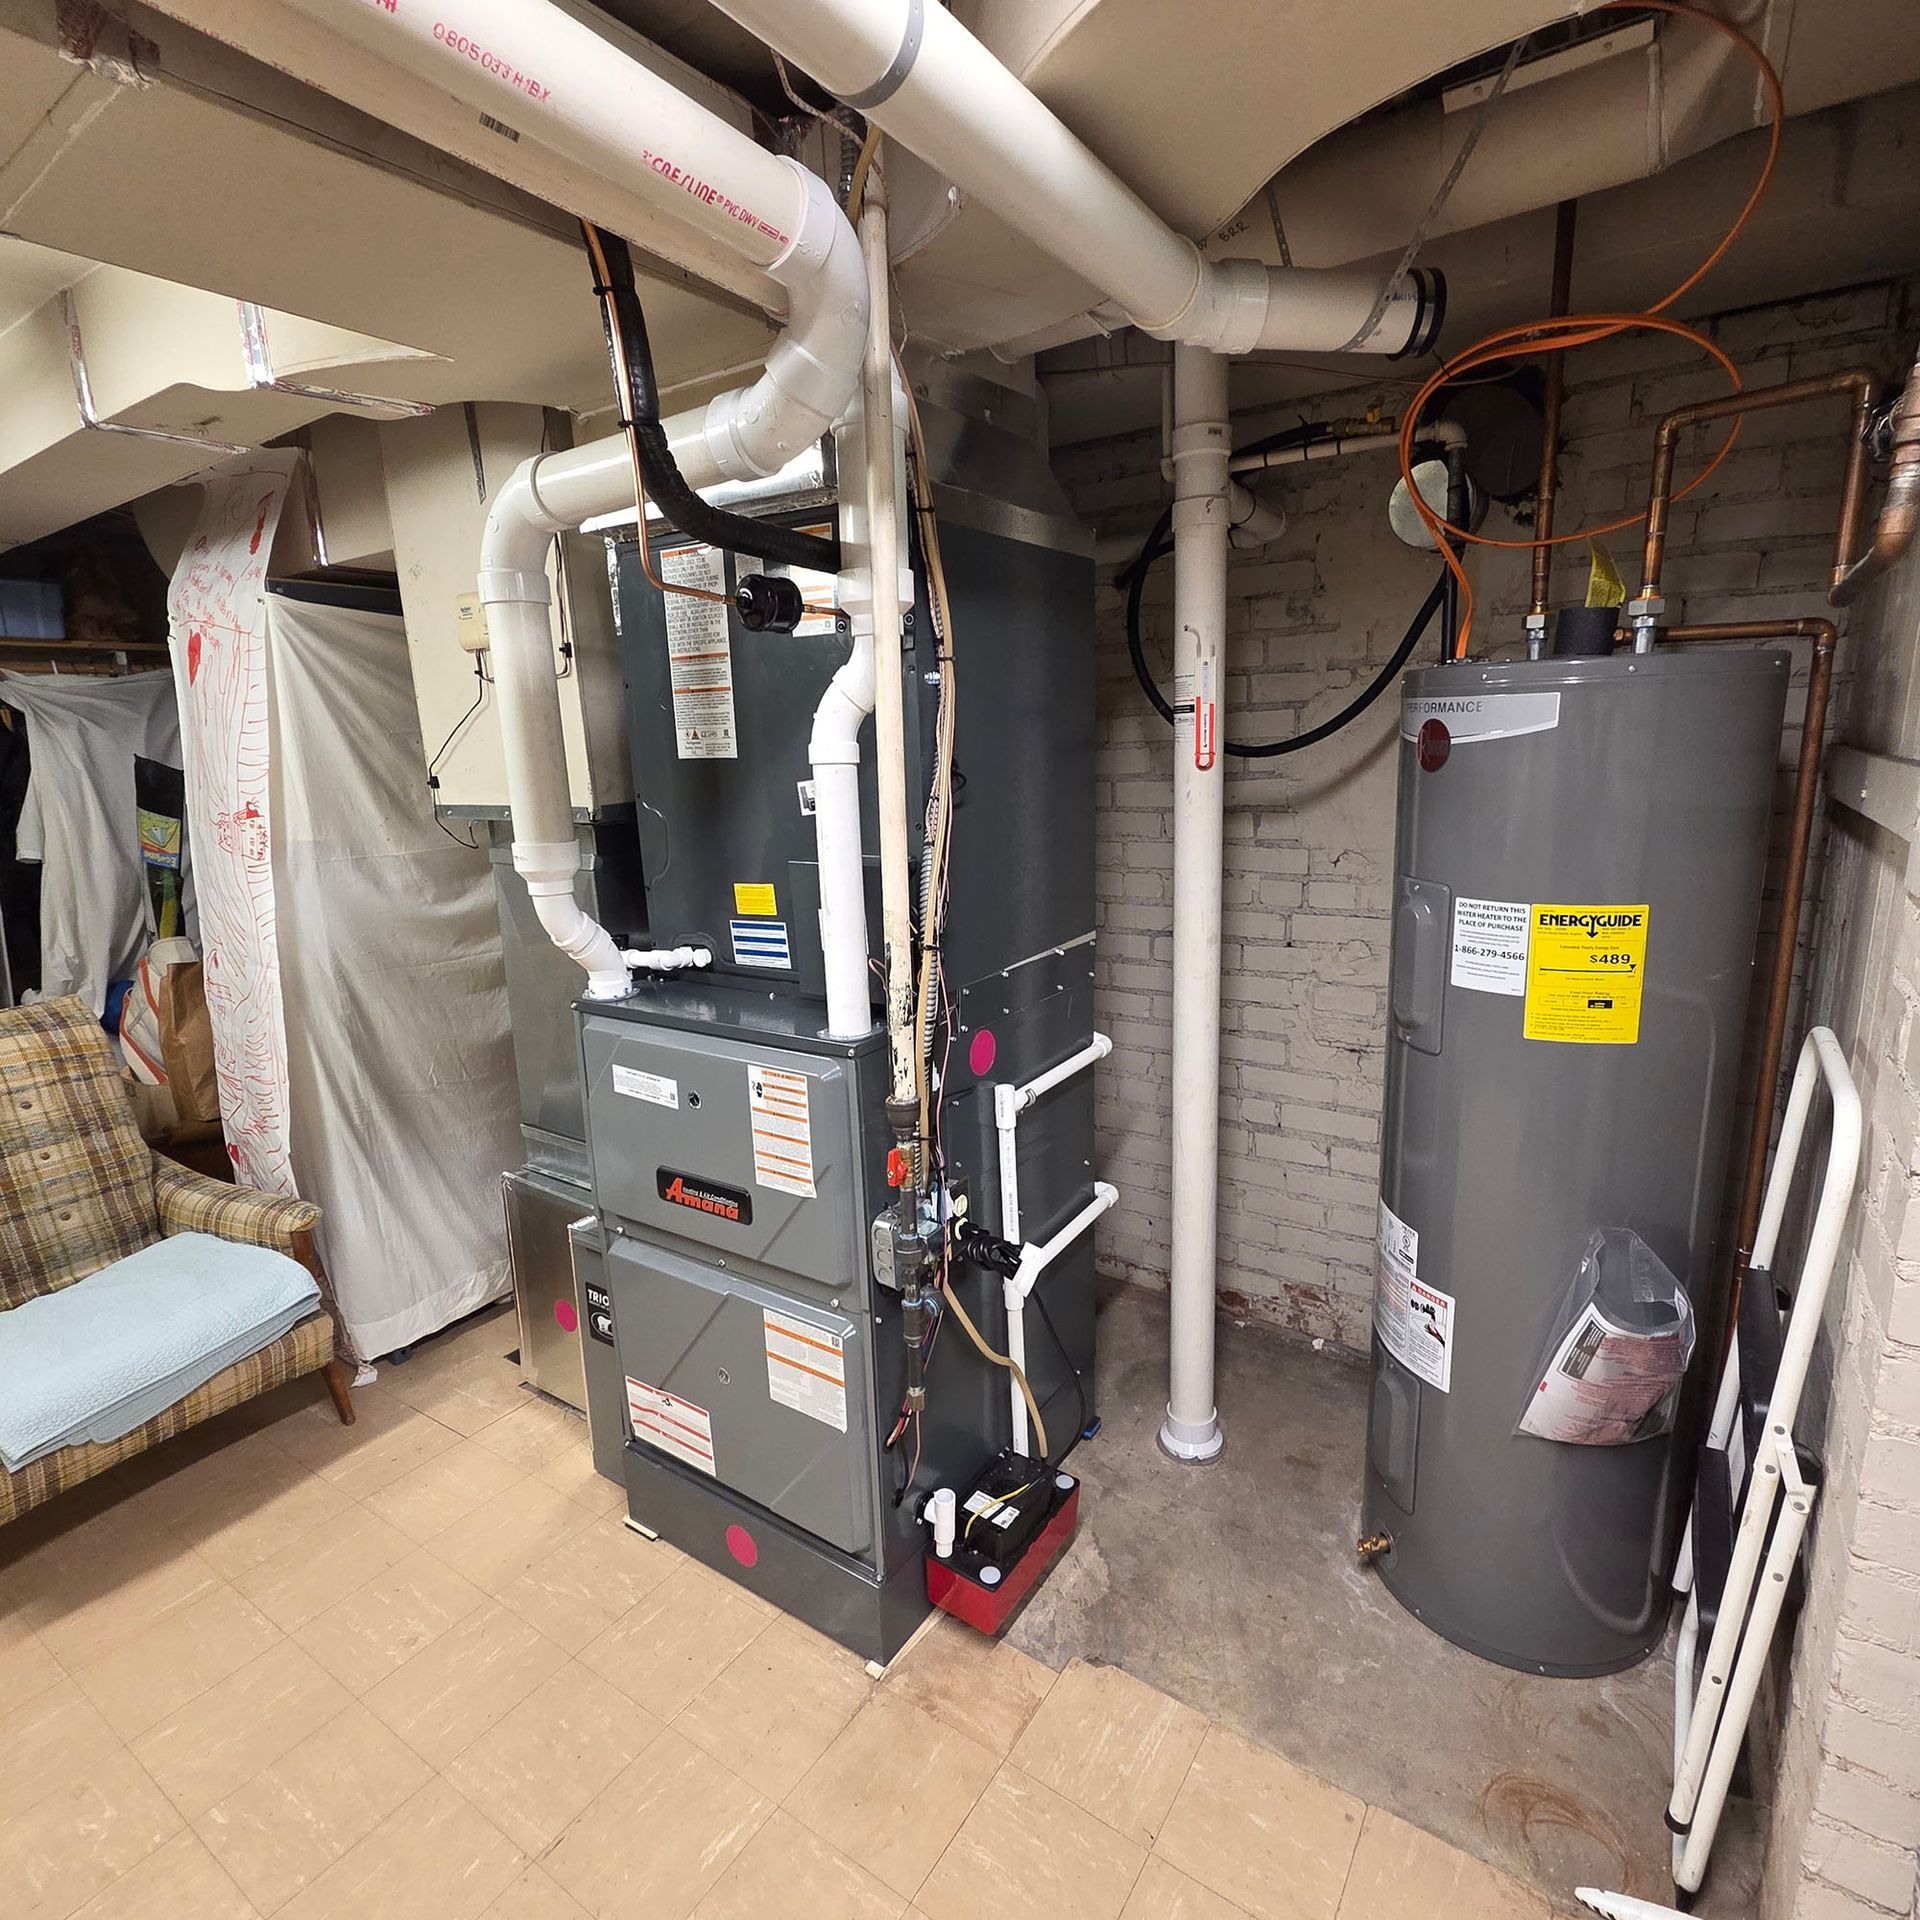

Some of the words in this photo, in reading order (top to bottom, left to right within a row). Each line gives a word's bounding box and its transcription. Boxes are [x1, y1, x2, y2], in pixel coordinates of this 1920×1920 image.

[723, 199, 739, 217] PVC
[1406, 701, 1483, 713] PERFORMANCE
[1477, 912, 1502, 920] HEATER
[1540, 914, 1642, 927] ENERGYGUIDE
[1487, 923, 1524, 931] PURCHASE
[1455, 944, 1525, 960] 1-866-279-4566
[665, 1177, 739, 1220] Amana
[1417, 1287, 1447, 1307] DANGER
